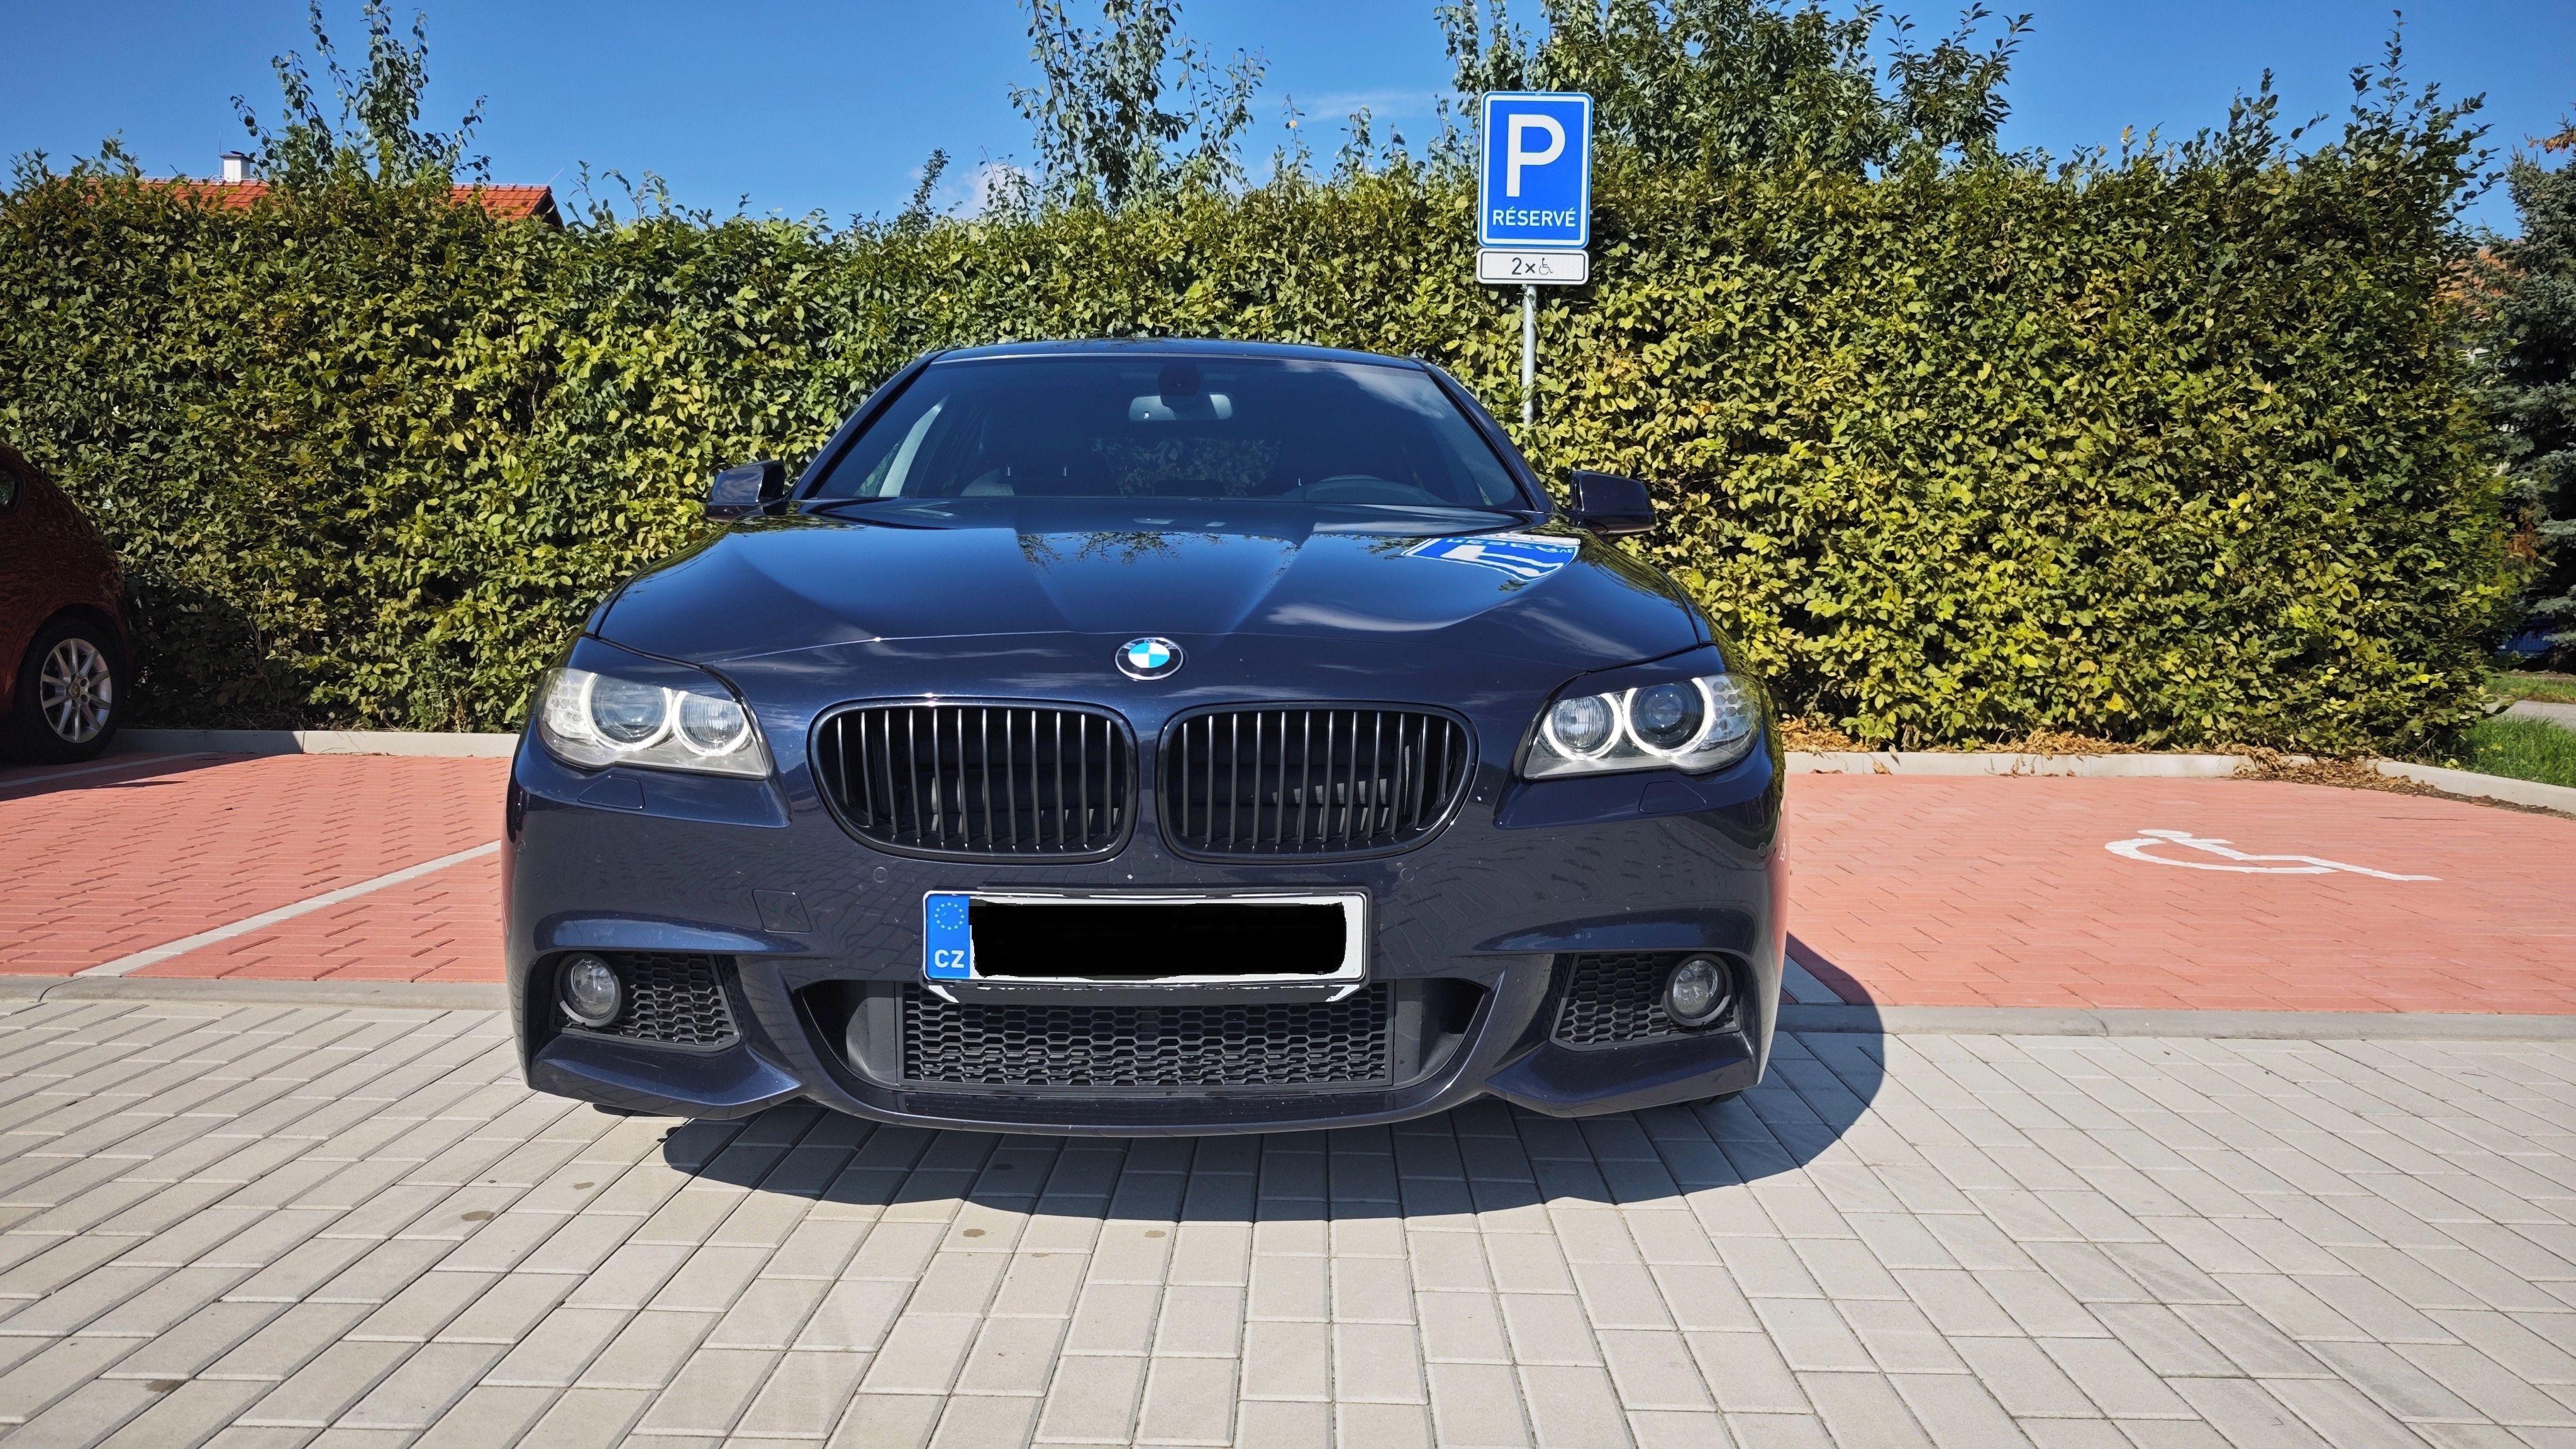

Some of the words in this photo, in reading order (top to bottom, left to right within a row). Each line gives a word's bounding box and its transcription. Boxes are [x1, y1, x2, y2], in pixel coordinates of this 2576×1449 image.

[1506, 114, 1566, 197] P
[1492, 206, 1576, 227] RÉSERVÉ
[1123, 638, 1177, 650] BMW
[935, 949, 965, 969] CZ
